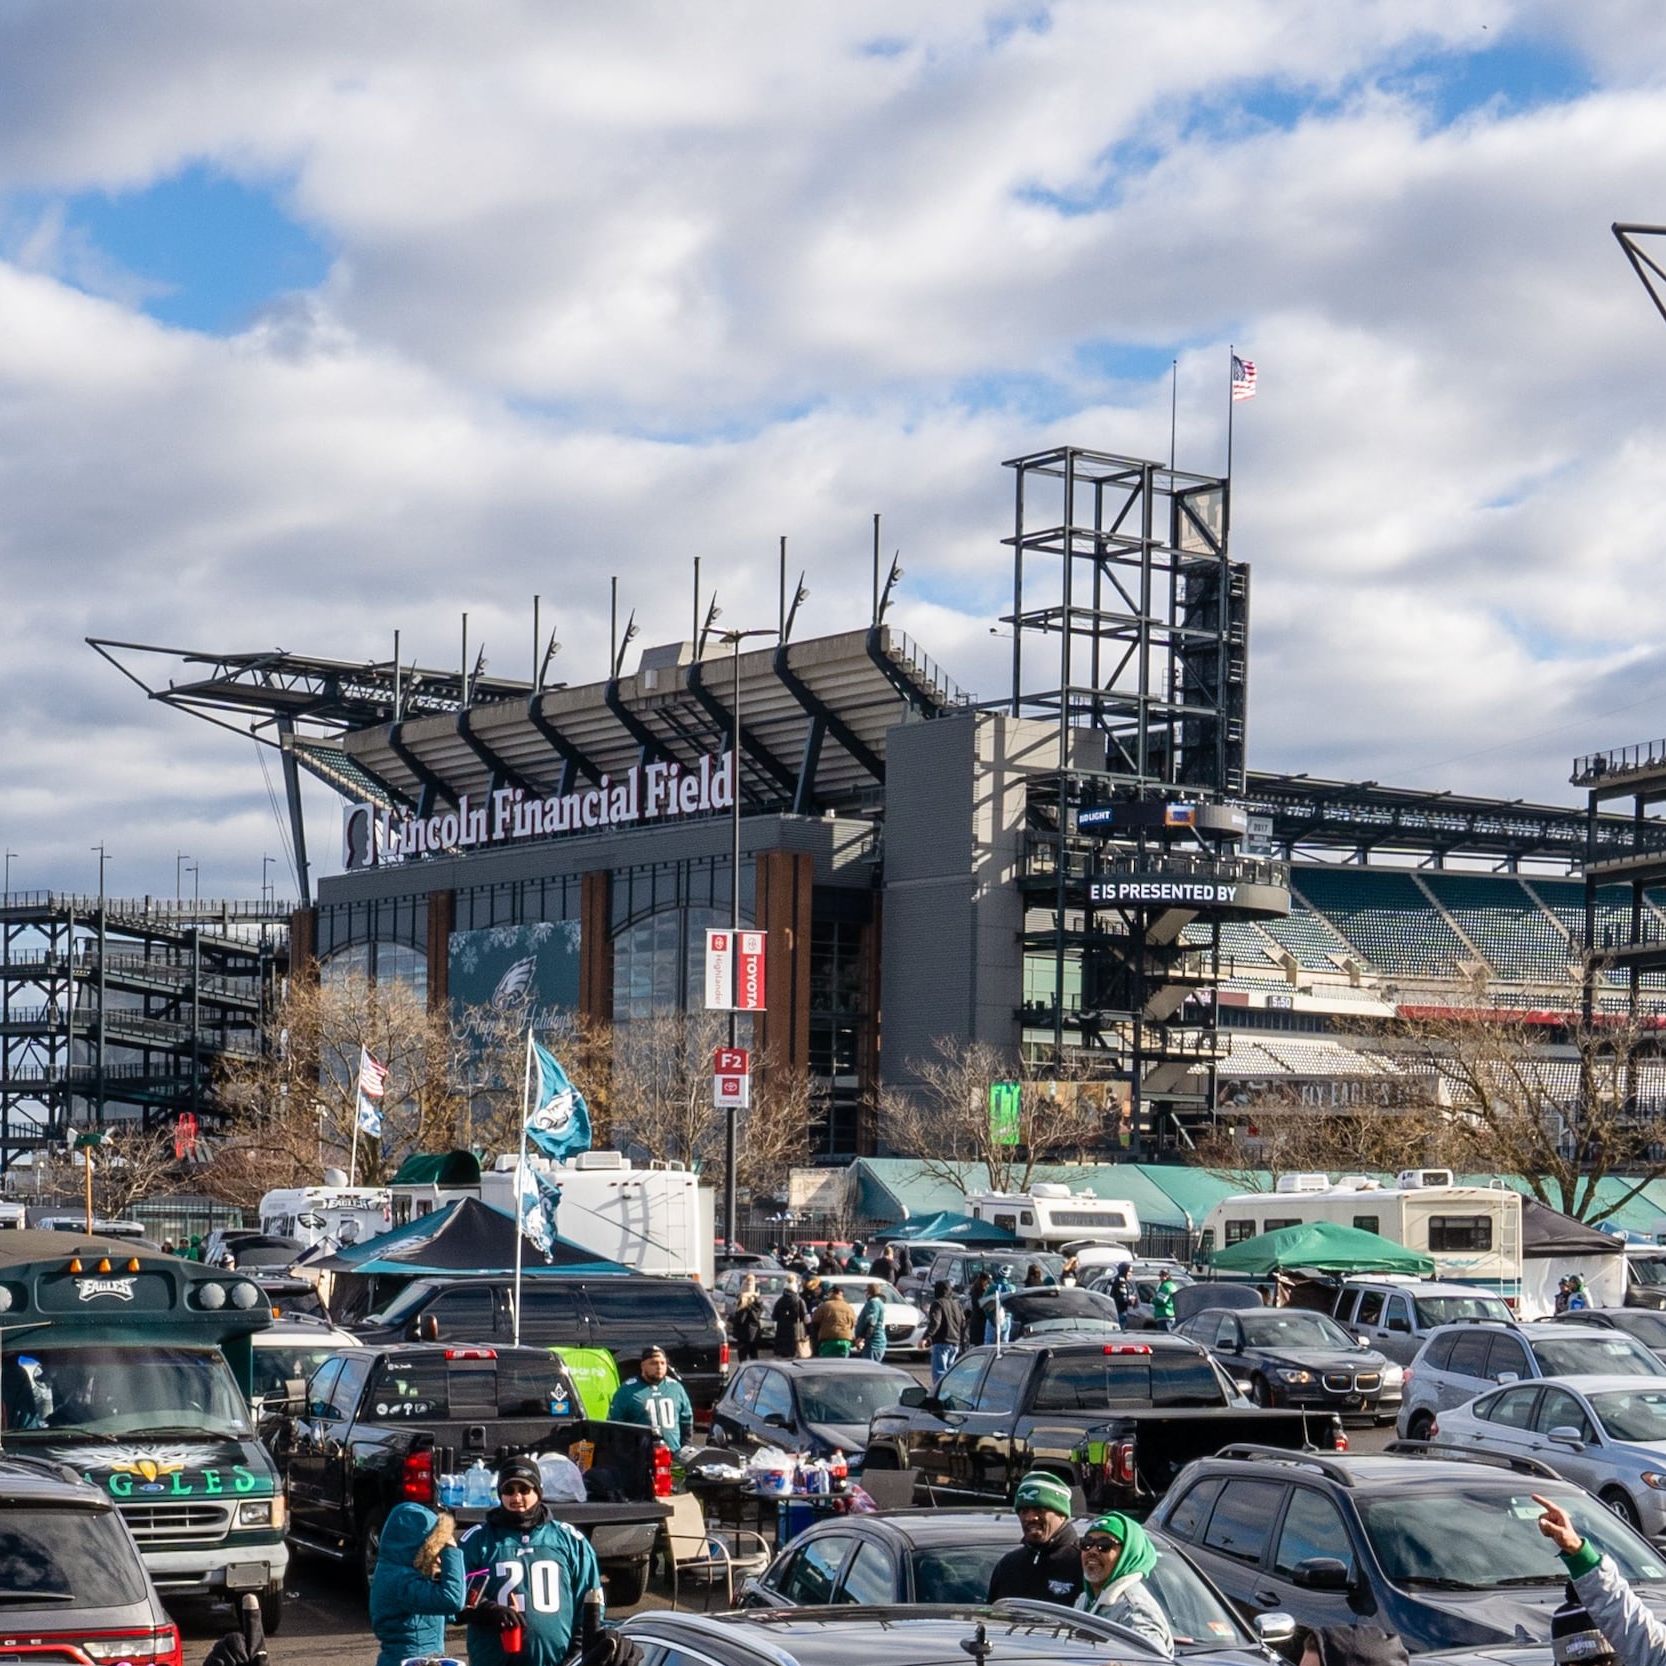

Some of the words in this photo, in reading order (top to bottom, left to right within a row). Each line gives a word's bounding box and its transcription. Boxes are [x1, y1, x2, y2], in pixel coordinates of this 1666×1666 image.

[382, 795, 488, 856] Lincoln
[493, 765, 639, 839] Financial
[645, 750, 733, 818] Field
[1091, 885, 1099, 900] E
[1102, 885, 1116, 900] IS
[1119, 884, 1214, 901] PRESENTED
[1217, 886, 1236, 901] BY
[715, 954, 725, 1005] Highlander
[746, 955, 758, 1009] TOYOTA
[721, 1054, 742, 1068] F2
[74, 1277, 138, 1300] EAGLES
[644, 1397, 674, 1429] 10
[495, 1559, 555, 1614] 20
